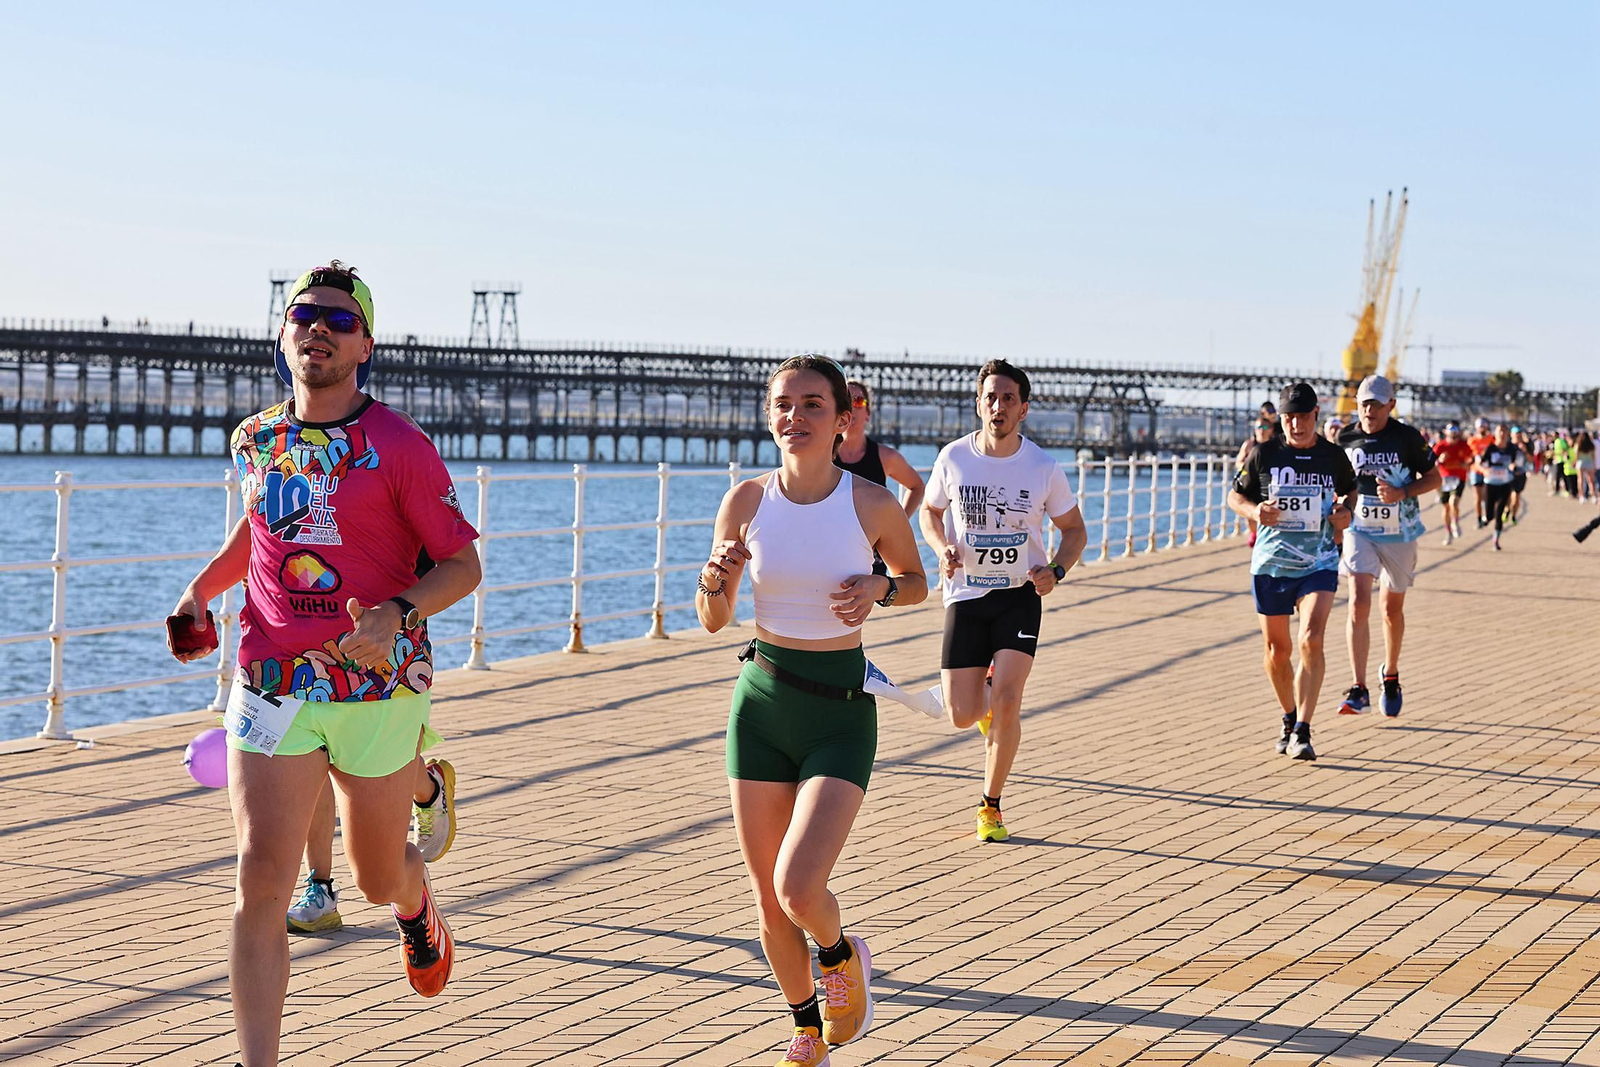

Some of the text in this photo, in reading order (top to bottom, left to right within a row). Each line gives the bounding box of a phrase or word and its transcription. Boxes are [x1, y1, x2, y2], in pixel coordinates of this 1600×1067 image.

[1364, 452, 1400, 465] HUELVA
[1270, 466, 1295, 486] 10
[265, 470, 311, 530] 10
[1278, 498, 1310, 511] 581
[1362, 507, 1391, 519] 919
[975, 547, 1018, 565] 799
[289, 596, 338, 613] WiHu
